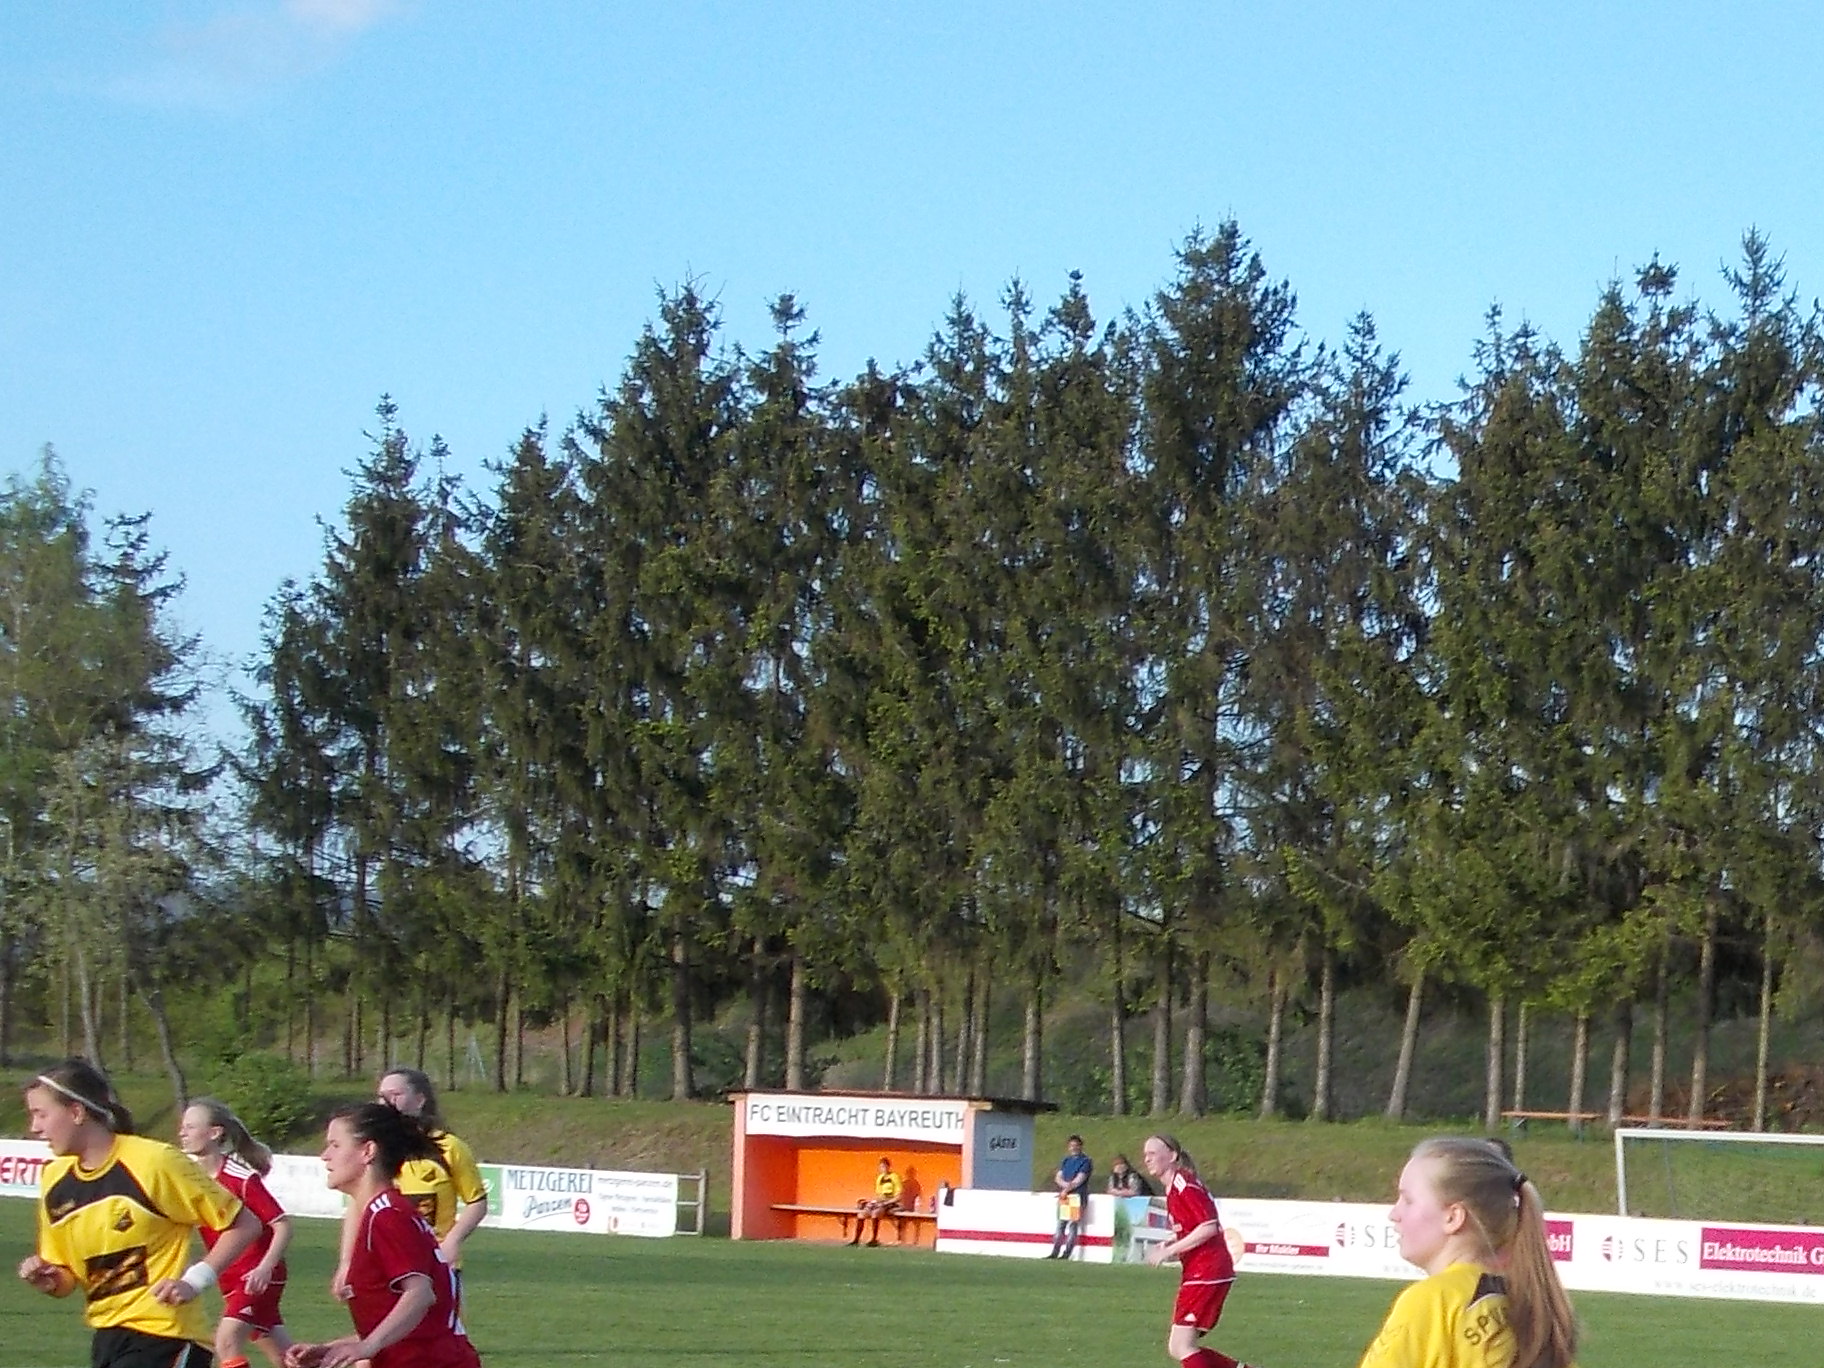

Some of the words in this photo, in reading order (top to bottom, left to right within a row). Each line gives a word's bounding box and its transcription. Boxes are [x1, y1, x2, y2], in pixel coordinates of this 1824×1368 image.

[750, 1104, 770, 1122] FC
[777, 1105, 869, 1126] EINTRACHT
[875, 1108, 964, 1129] BAYREUTH
[506, 1168, 593, 1194] METZGEREI
[1547, 1234, 1571, 1252] bH
[1703, 1242, 1808, 1265] Elektrotechnik
